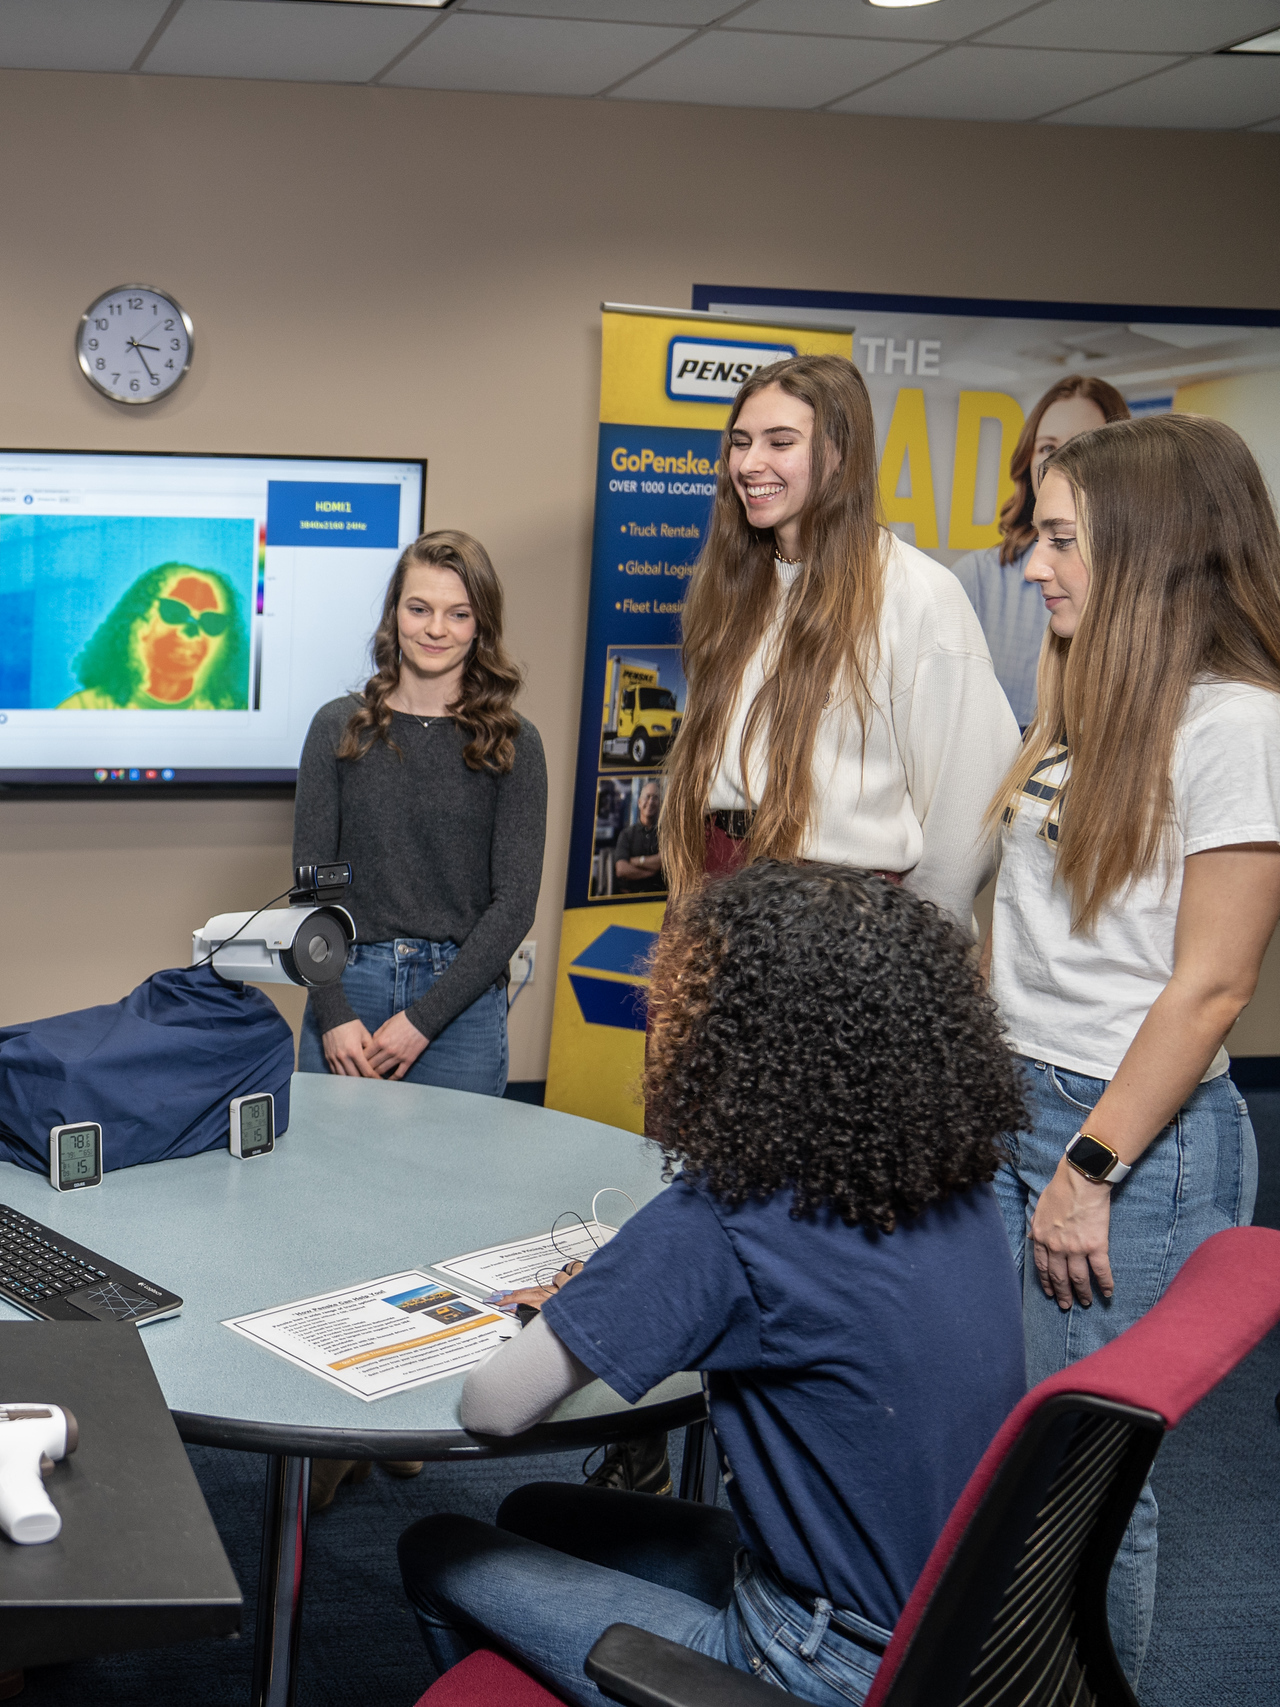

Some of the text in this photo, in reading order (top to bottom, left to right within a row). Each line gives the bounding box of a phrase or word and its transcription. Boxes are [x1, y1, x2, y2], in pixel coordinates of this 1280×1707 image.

[108, 304, 122, 315] 11
[126, 298, 143, 310] 12
[151, 304, 158, 315] 1
[95, 318, 109, 331] 10
[164, 319, 175, 331] 2
[88, 339, 98, 351] 9
[170, 339, 180, 351] 3
[860, 337, 941, 377] THE
[96, 358, 106, 370] 8
[165, 359, 174, 370] 4
[111, 373, 121, 385] 7
[129, 379, 140, 391] 6
[150, 373, 160, 386] 5
[609, 479, 638, 493] OVER
[640, 480, 665, 494] 1000
[315, 501, 352, 513] HDMI1
[299, 520, 367, 531] 3840x2160 24Hz
[628, 522, 700, 539] Truck Rentals
[625, 560, 662, 575] Global
[623, 598, 651, 613] Fleet
[248, 1105, 259, 1118] 78
[254, 1128, 262, 1142] 15
[70, 1135, 84, 1149] 78
[77, 1160, 87, 1174] 15
